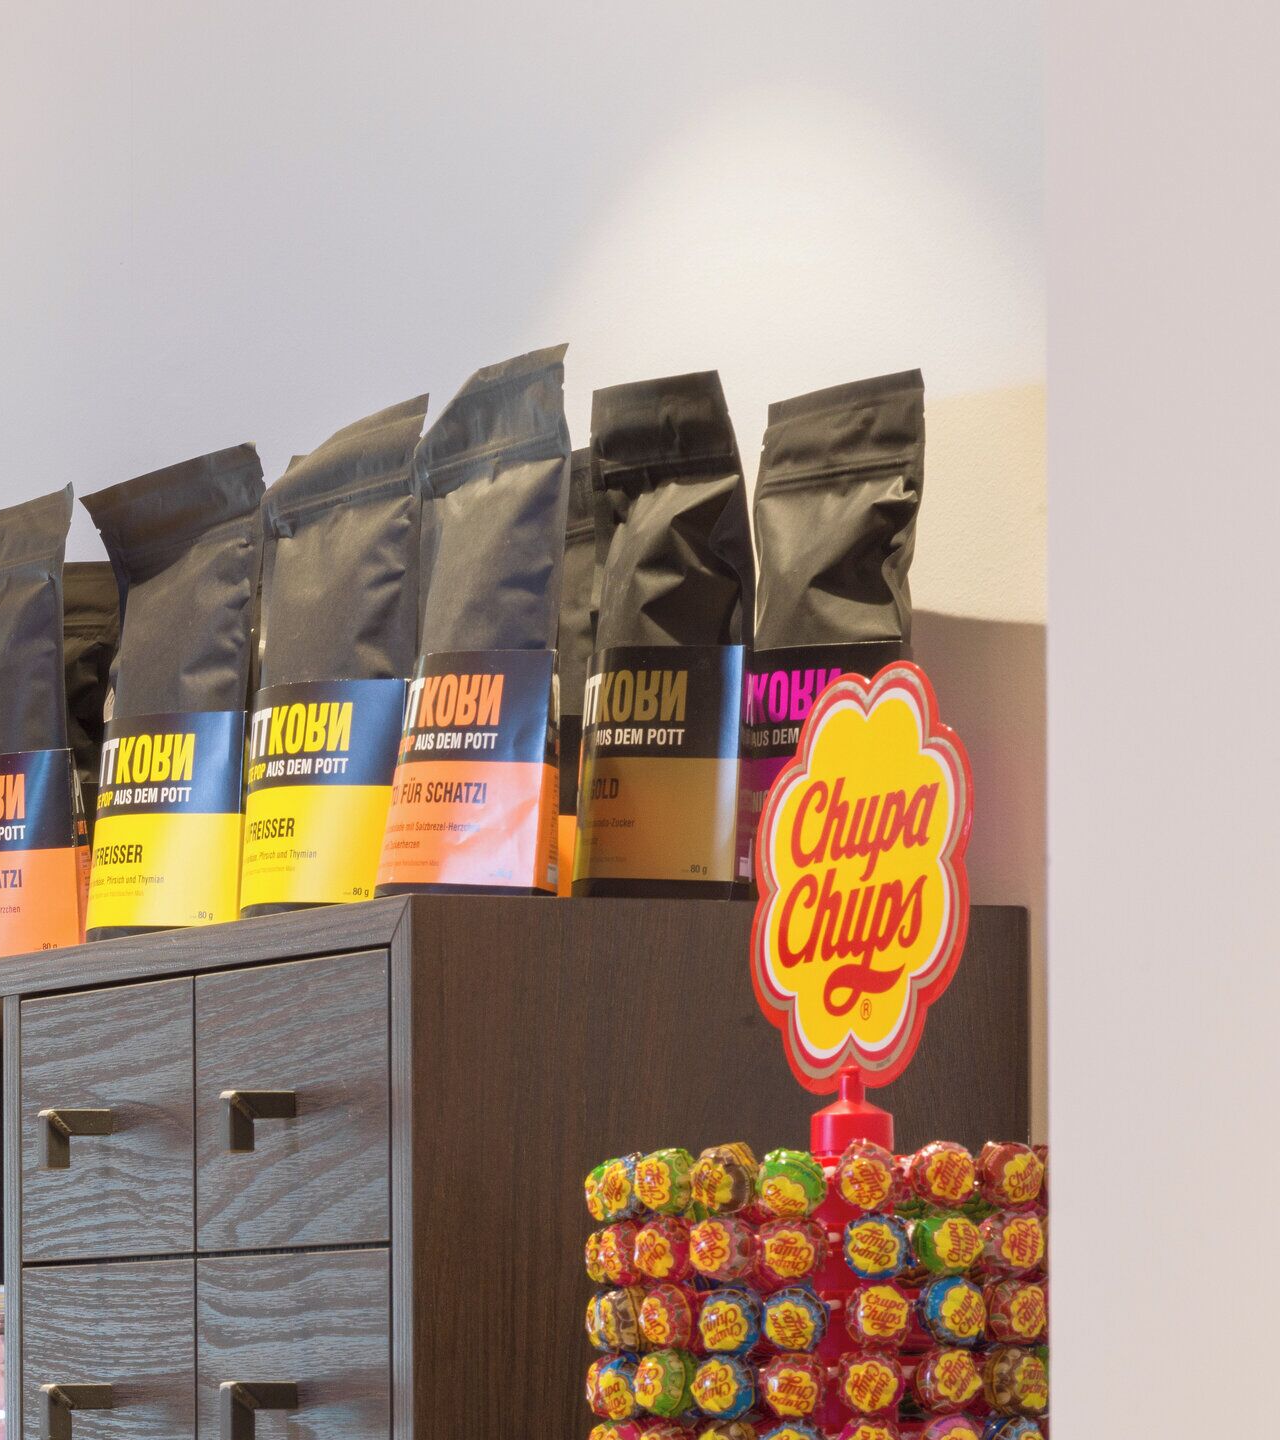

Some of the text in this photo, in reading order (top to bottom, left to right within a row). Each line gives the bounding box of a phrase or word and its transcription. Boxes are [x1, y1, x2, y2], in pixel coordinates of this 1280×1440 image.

[416, 732, 498, 750] AUS DEM POTT
[596, 728, 685, 746] AUS DEM POTT
[751, 728, 798, 747] AUS DEM
[266, 757, 348, 777] AUS DEM POTT
[114, 787, 192, 805] AUS DEM POTT
[425, 783, 487, 804] SCHATZI
[790, 776, 940, 882] Chupa
[690, 864, 701, 874] 80
[352, 888, 363, 896] 80
[198, 912, 206, 920] 80
[778, 867, 928, 985] Chups
